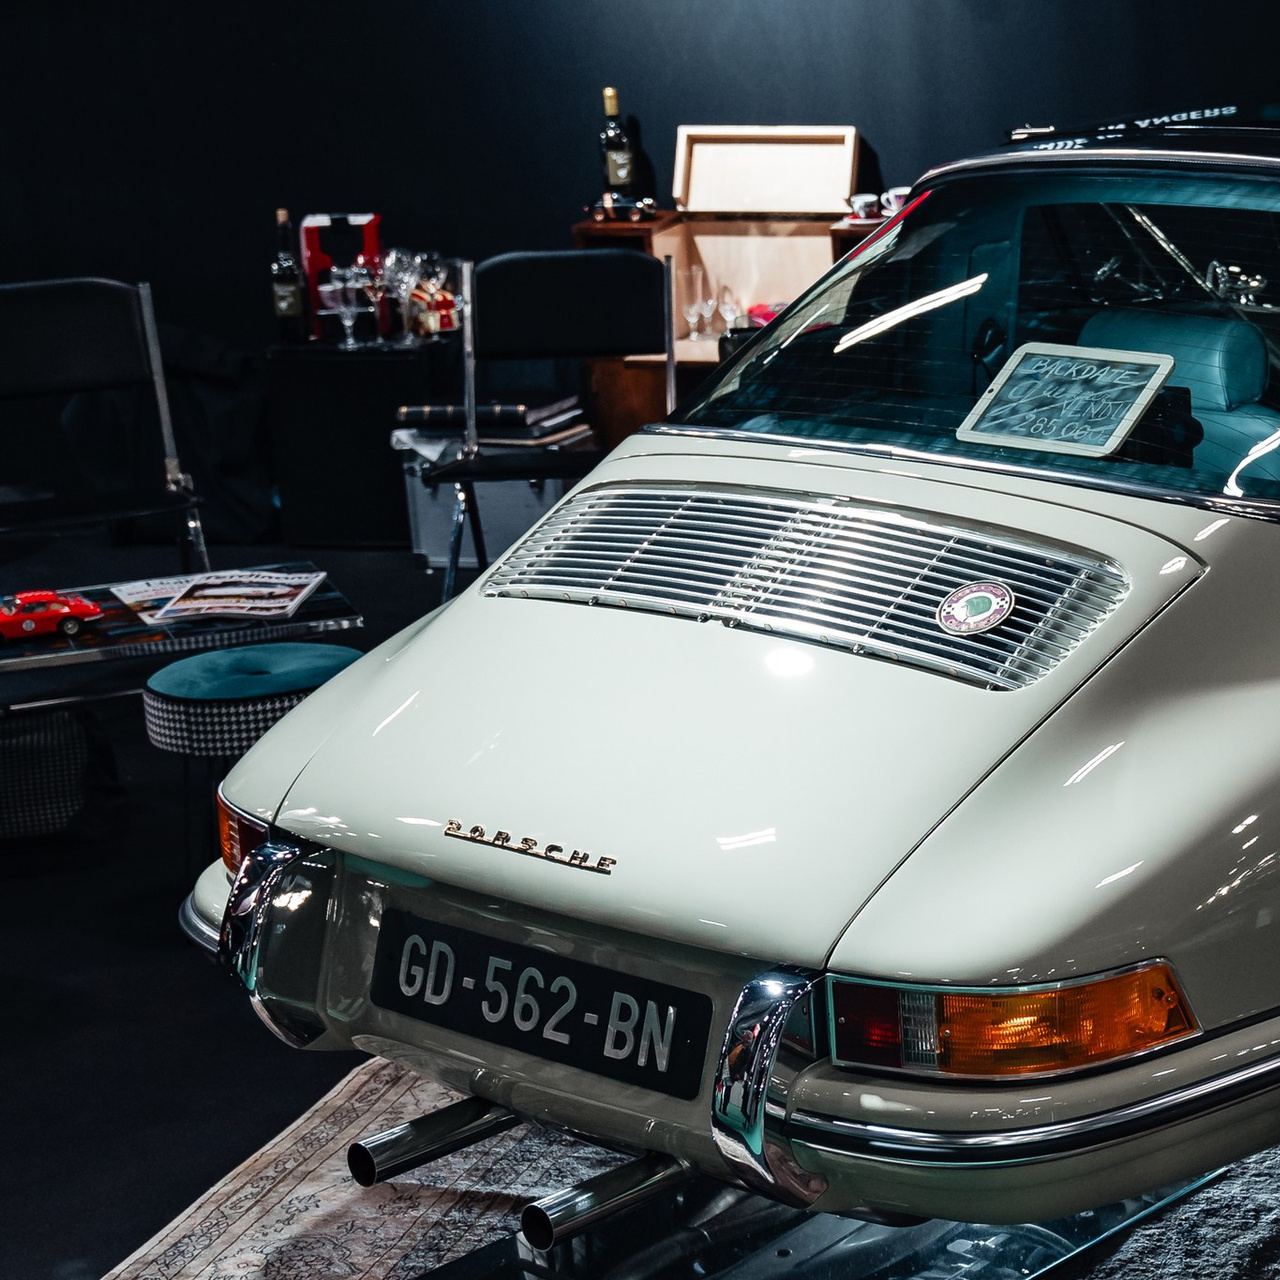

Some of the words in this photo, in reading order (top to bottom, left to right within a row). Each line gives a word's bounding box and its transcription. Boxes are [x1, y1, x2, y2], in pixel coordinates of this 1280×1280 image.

[1032, 357, 1140, 384] BACKDATE
[1011, 413, 1056, 436] 285
[445, 818, 618, 874] PORSCHE
[398, 934, 678, 1073] GD-562-BN
